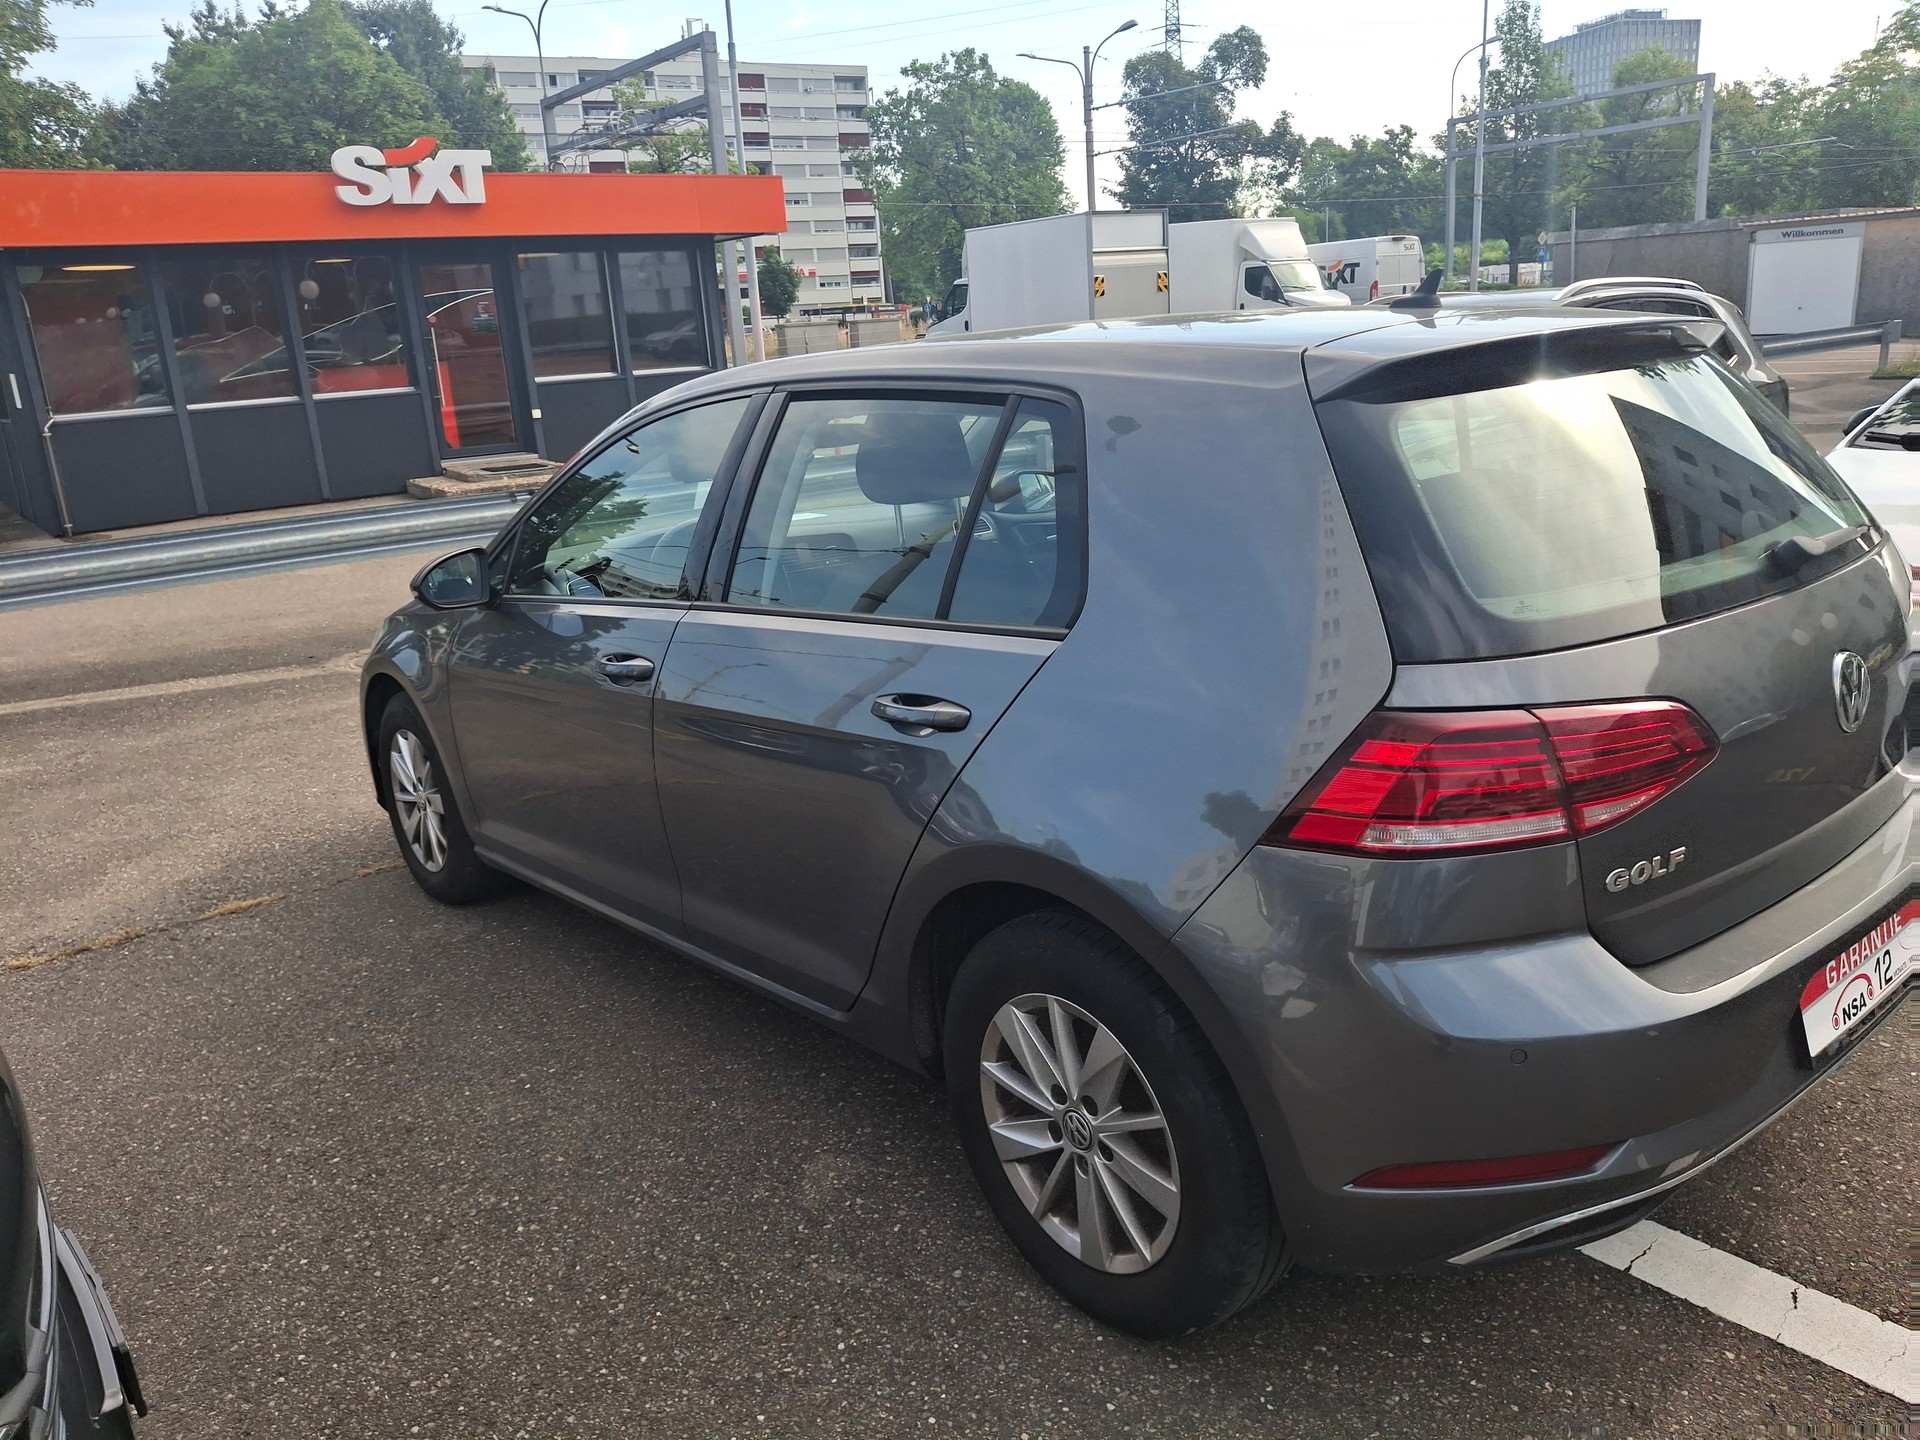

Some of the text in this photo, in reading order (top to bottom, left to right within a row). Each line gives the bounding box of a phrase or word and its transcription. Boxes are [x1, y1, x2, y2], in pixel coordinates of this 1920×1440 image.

[1781, 228, 1844, 239] Willkommen
[1605, 846, 1686, 893] GOLF
[1825, 912, 1902, 989] GARANTIE
[1874, 949, 1893, 990] 12
[1842, 992, 1867, 1025] NSA
